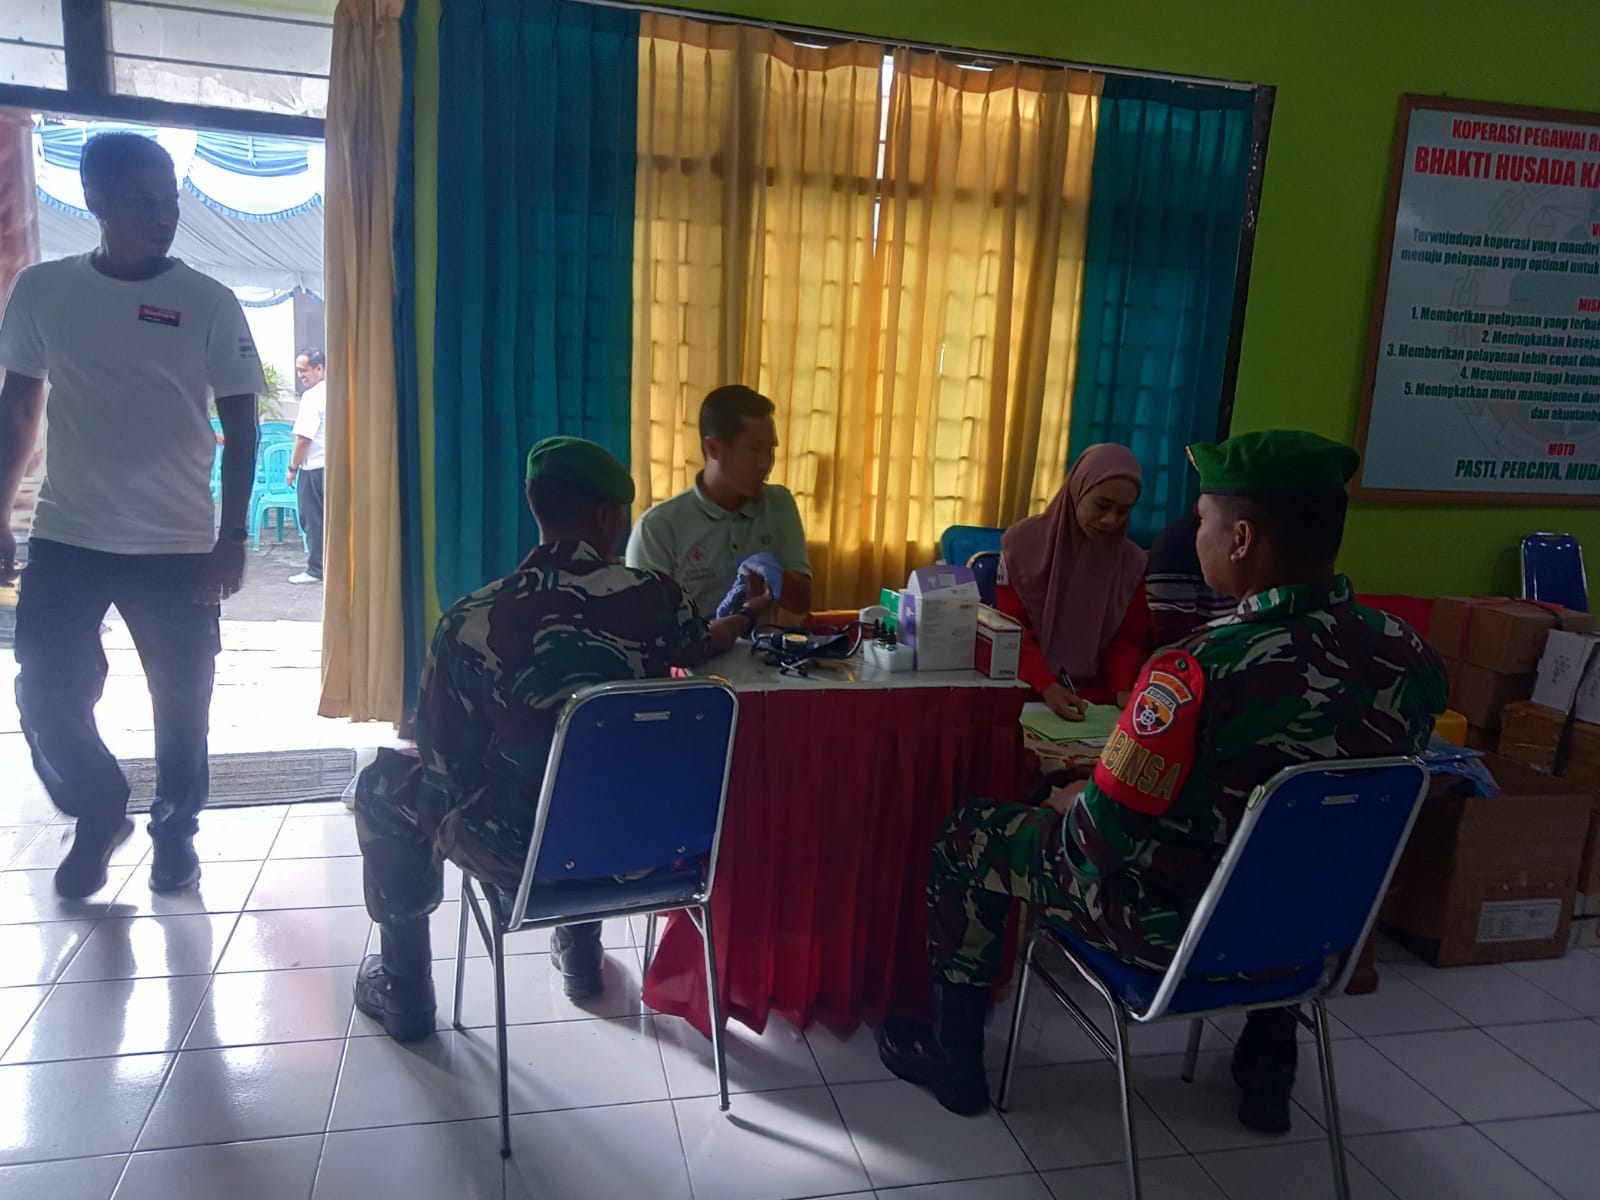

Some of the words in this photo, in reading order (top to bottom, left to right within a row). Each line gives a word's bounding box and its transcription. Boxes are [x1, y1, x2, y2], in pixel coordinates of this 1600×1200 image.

[1452, 119, 1521, 144] KOPERASI
[1524, 126, 1586, 150] PEGAWAI
[1414, 146, 1492, 179] BHAKTI
[1495, 154, 1575, 186] HUSADA
[1413, 228, 1482, 247] Terwujudnya
[1484, 234, 1530, 249] koperasi
[1532, 239, 1556, 253] yang
[1558, 241, 1600, 255] mandiri
[1401, 249, 1442, 264] menuju
[1444, 252, 1499, 268] pelayanan
[1501, 257, 1527, 271] yang
[1529, 258, 1568, 272] optimal
[1570, 262, 1600, 274] untuk
[1411, 307, 1418, 319] 1.
[1420, 307, 1486, 323] Memberikan
[1488, 313, 1541, 327] pelayanan
[1543, 317, 1568, 331] yang
[1481, 330, 1490, 343] 2.
[1492, 331, 1565, 347] Meningkatkan
[1387, 344, 1396, 356] 3.
[1398, 344, 1464, 360] Memberikan
[1466, 349, 1520, 364] pelayanan
[1521, 352, 1547, 365] lebih
[1549, 354, 1578, 368] cepat
[1460, 366, 1469, 379] 4.
[1470, 367, 1531, 384] Menjunjung
[1533, 370, 1563, 386] tinggi
[1404, 382, 1413, 395] 5.
[1415, 383, 1488, 399] Meningkatkan
[1490, 388, 1516, 400] mutu
[1530, 406, 1549, 419] dan
[1548, 443, 1575, 456] MOTO
